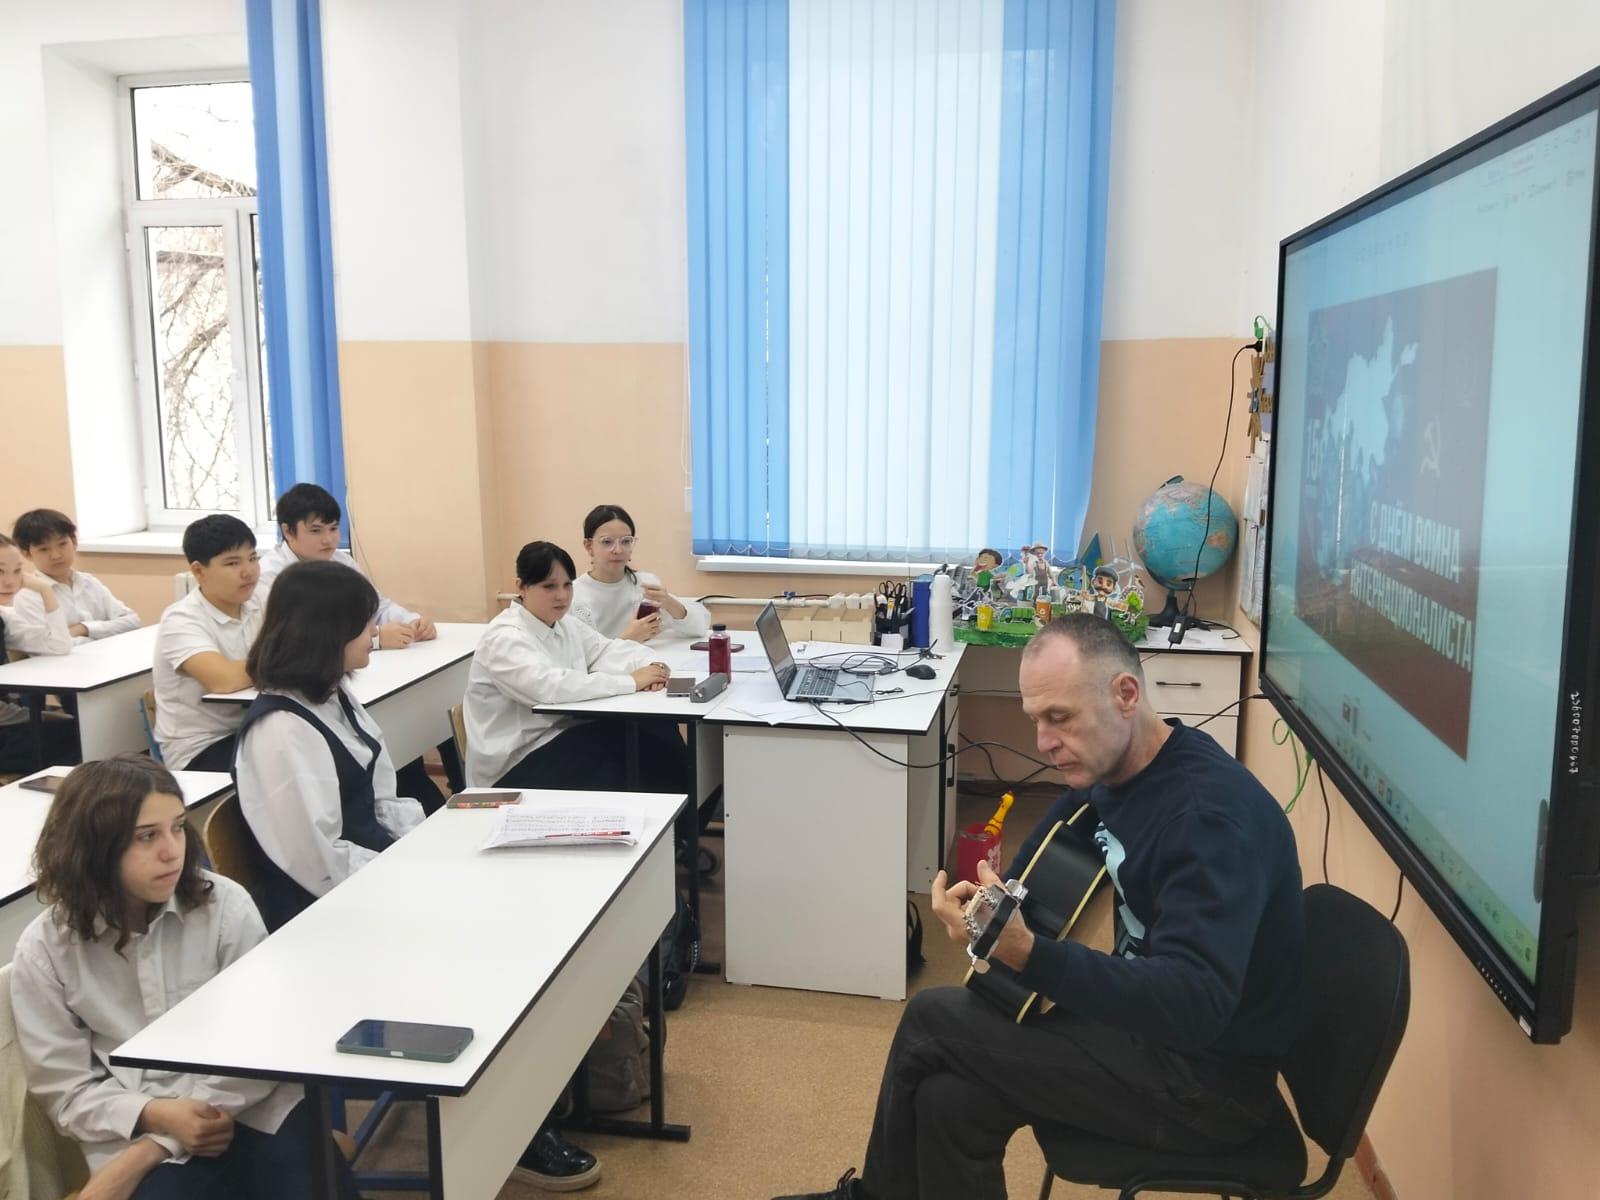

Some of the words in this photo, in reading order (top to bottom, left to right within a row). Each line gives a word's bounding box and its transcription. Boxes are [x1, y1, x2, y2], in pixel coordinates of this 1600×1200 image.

[1369, 500, 1377, 545] С
[1377, 499, 1413, 561] ДНЁМ
[1413, 514, 1461, 584] ВОИНА
